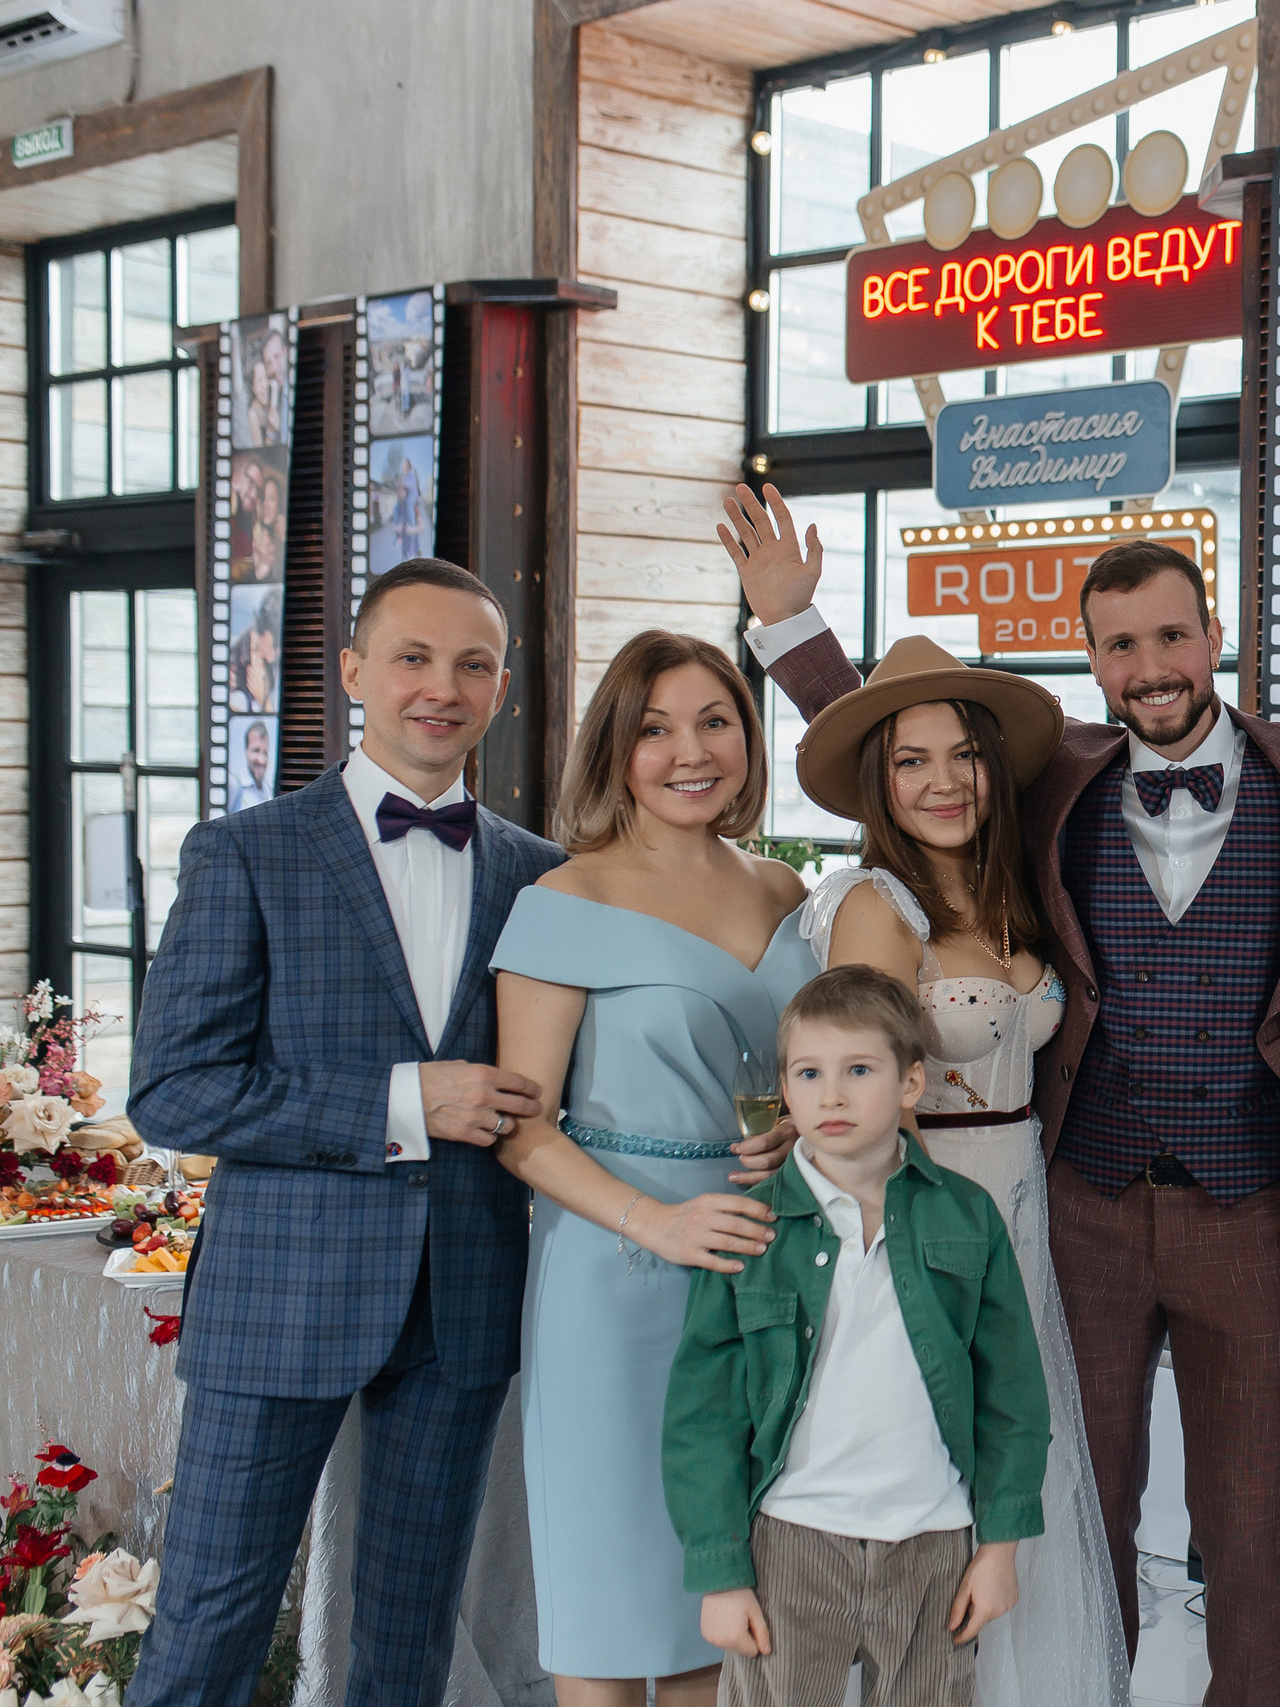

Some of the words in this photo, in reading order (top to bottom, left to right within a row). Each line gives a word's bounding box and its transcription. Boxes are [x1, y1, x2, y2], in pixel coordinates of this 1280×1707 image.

[15, 126, 61, 158] ВЫХОД
[863, 267, 931, 319] ВСЕ
[935, 243, 1095, 317] ДОРОГИ
[1106, 220, 1243, 287] ВЕДУТ
[975, 305, 1000, 350] К
[1009, 292, 1104, 345] ТЕБЕ
[959, 410, 1143, 453] Анастасия
[969, 446, 1128, 492] Владимир
